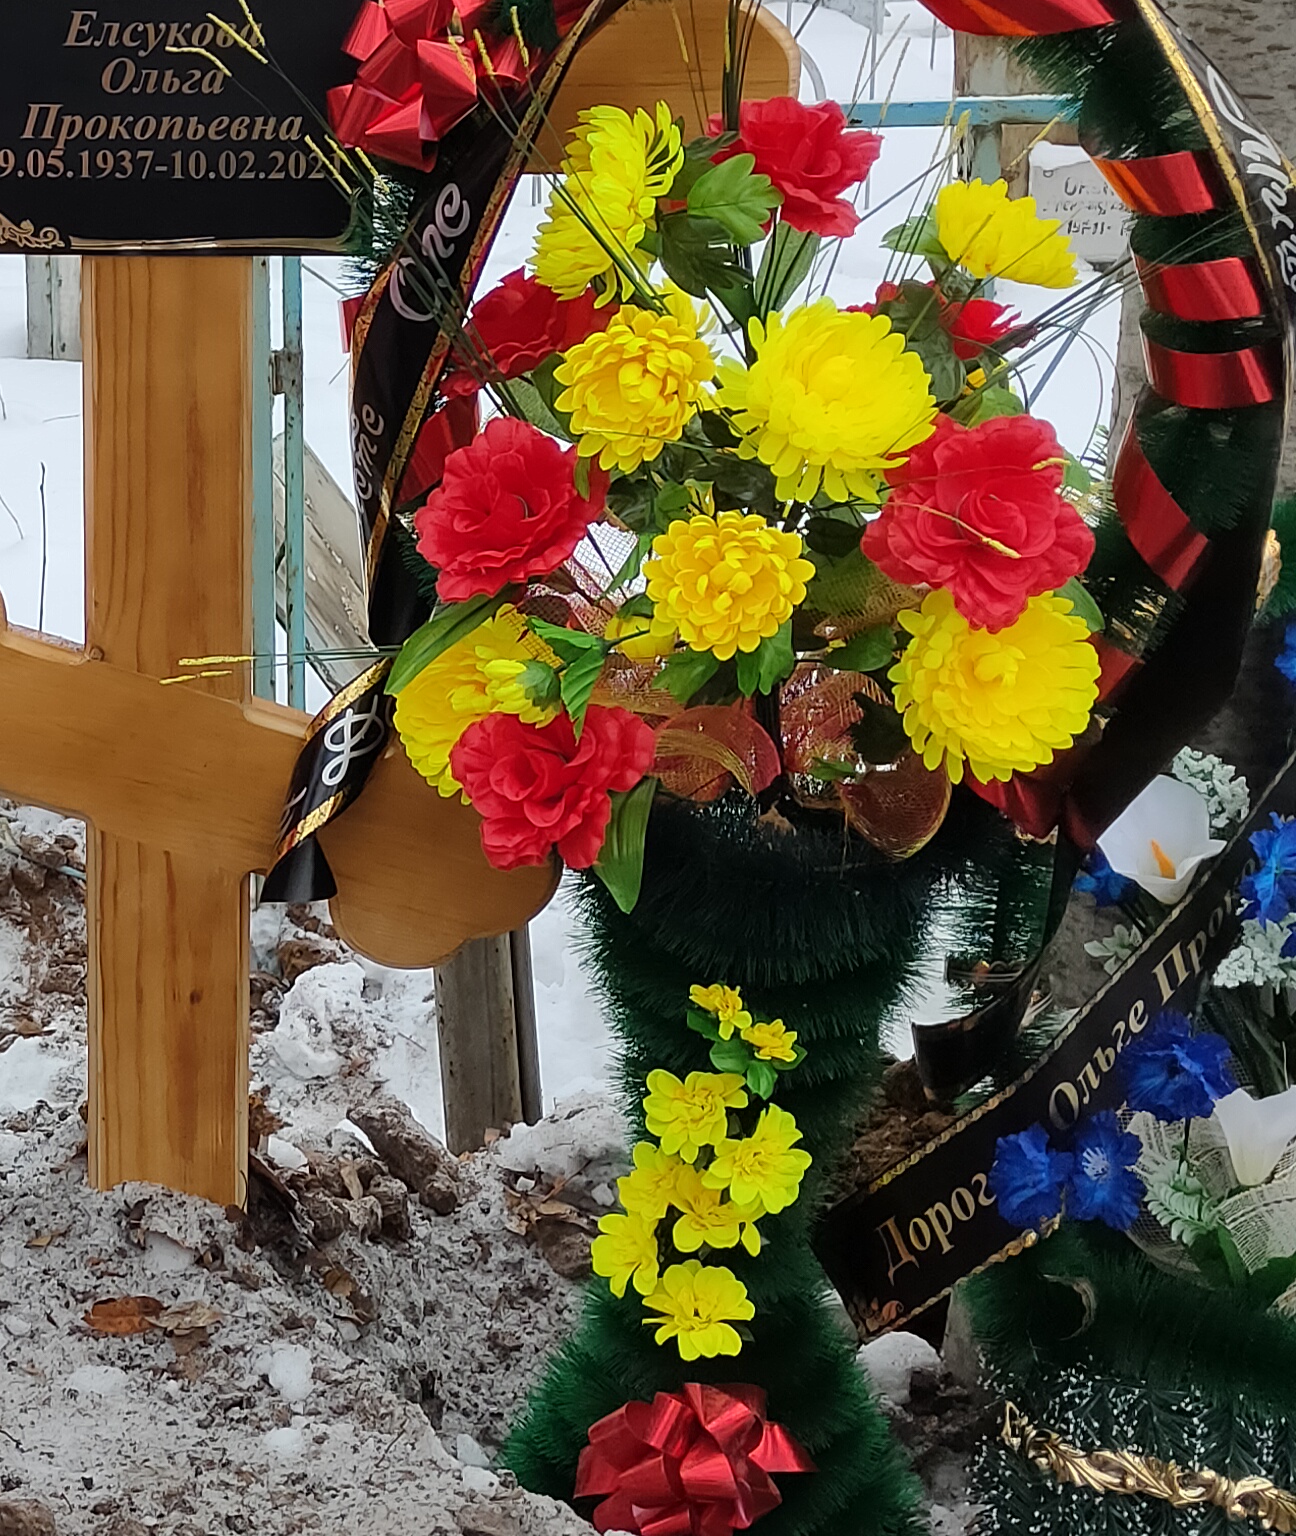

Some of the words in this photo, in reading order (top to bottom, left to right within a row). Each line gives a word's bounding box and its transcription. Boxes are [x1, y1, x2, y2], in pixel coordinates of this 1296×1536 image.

[101, 57, 225, 95] Ольга
[20, 103, 303, 150] Прокопьевна
[873, 1171, 997, 1286] Дорог
[1049, 998, 1150, 1131] Ольге
